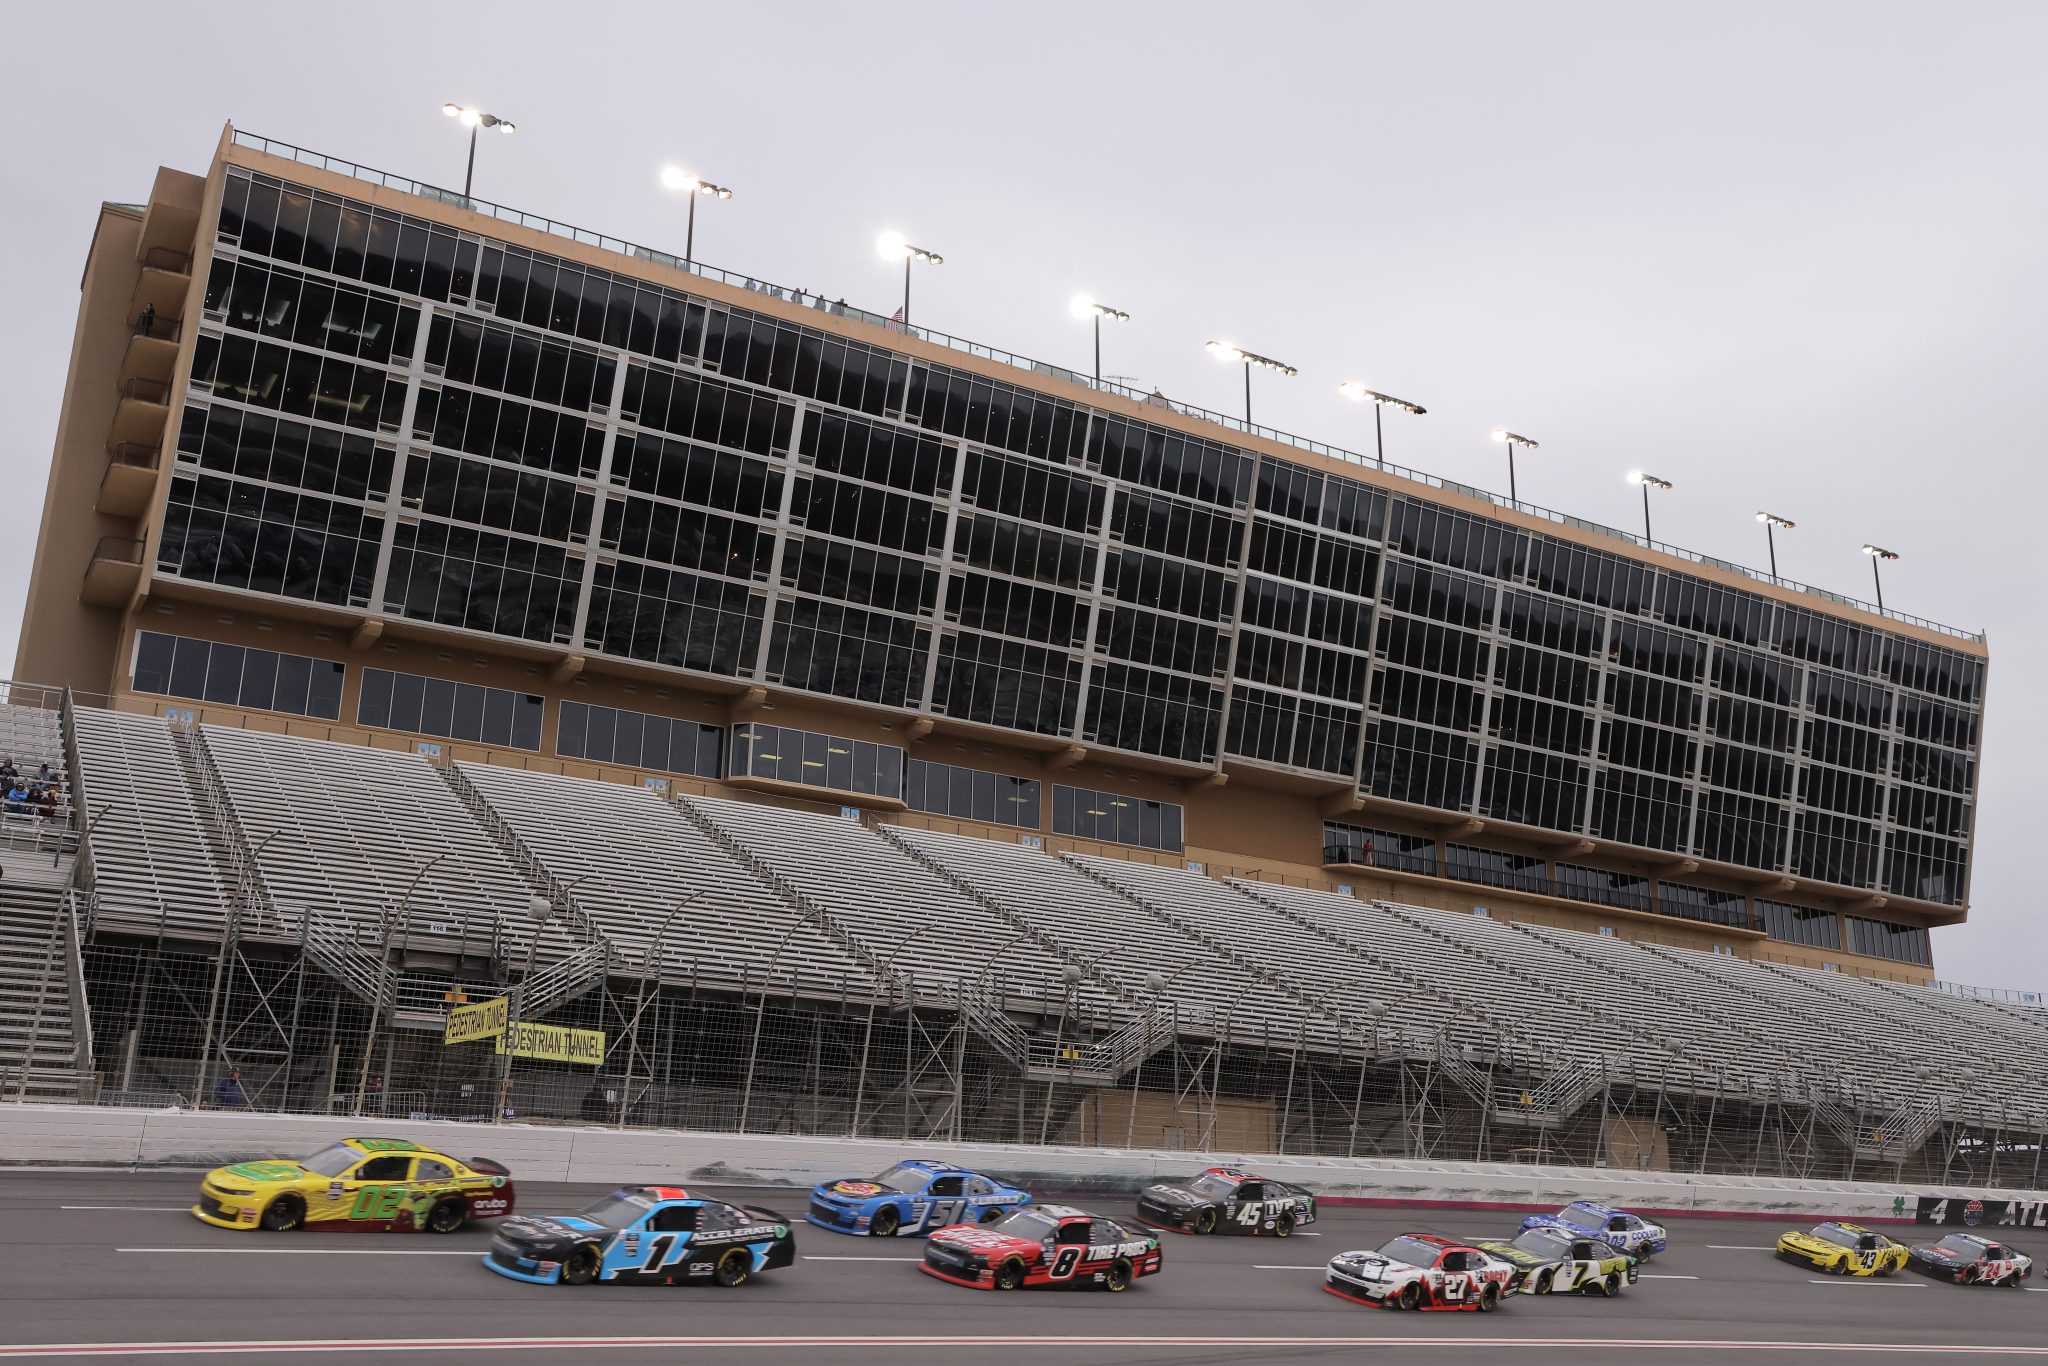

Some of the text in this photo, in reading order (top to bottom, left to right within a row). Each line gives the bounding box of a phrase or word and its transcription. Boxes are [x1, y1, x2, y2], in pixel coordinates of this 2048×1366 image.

[449, 1003, 504, 1038] PEDESTRIAN TUNNEL
[564, 1033, 600, 1058] TUNNEL
[351, 1185, 405, 1219] 02
[927, 1200, 968, 1227] 51
[1236, 1203, 1263, 1225] 45
[1930, 1200, 1949, 1225] 4
[690, 1225, 775, 1241] ACCELERATE
[638, 1233, 679, 1273] 1
[1049, 1247, 1082, 1278] 8
[1087, 1241, 1148, 1260] TIRE PROS
[1861, 1252, 1877, 1269] 43
[1573, 1261, 1589, 1287] 7
[1986, 1263, 2000, 1278] 24
[1445, 1275, 1468, 1299] 27
